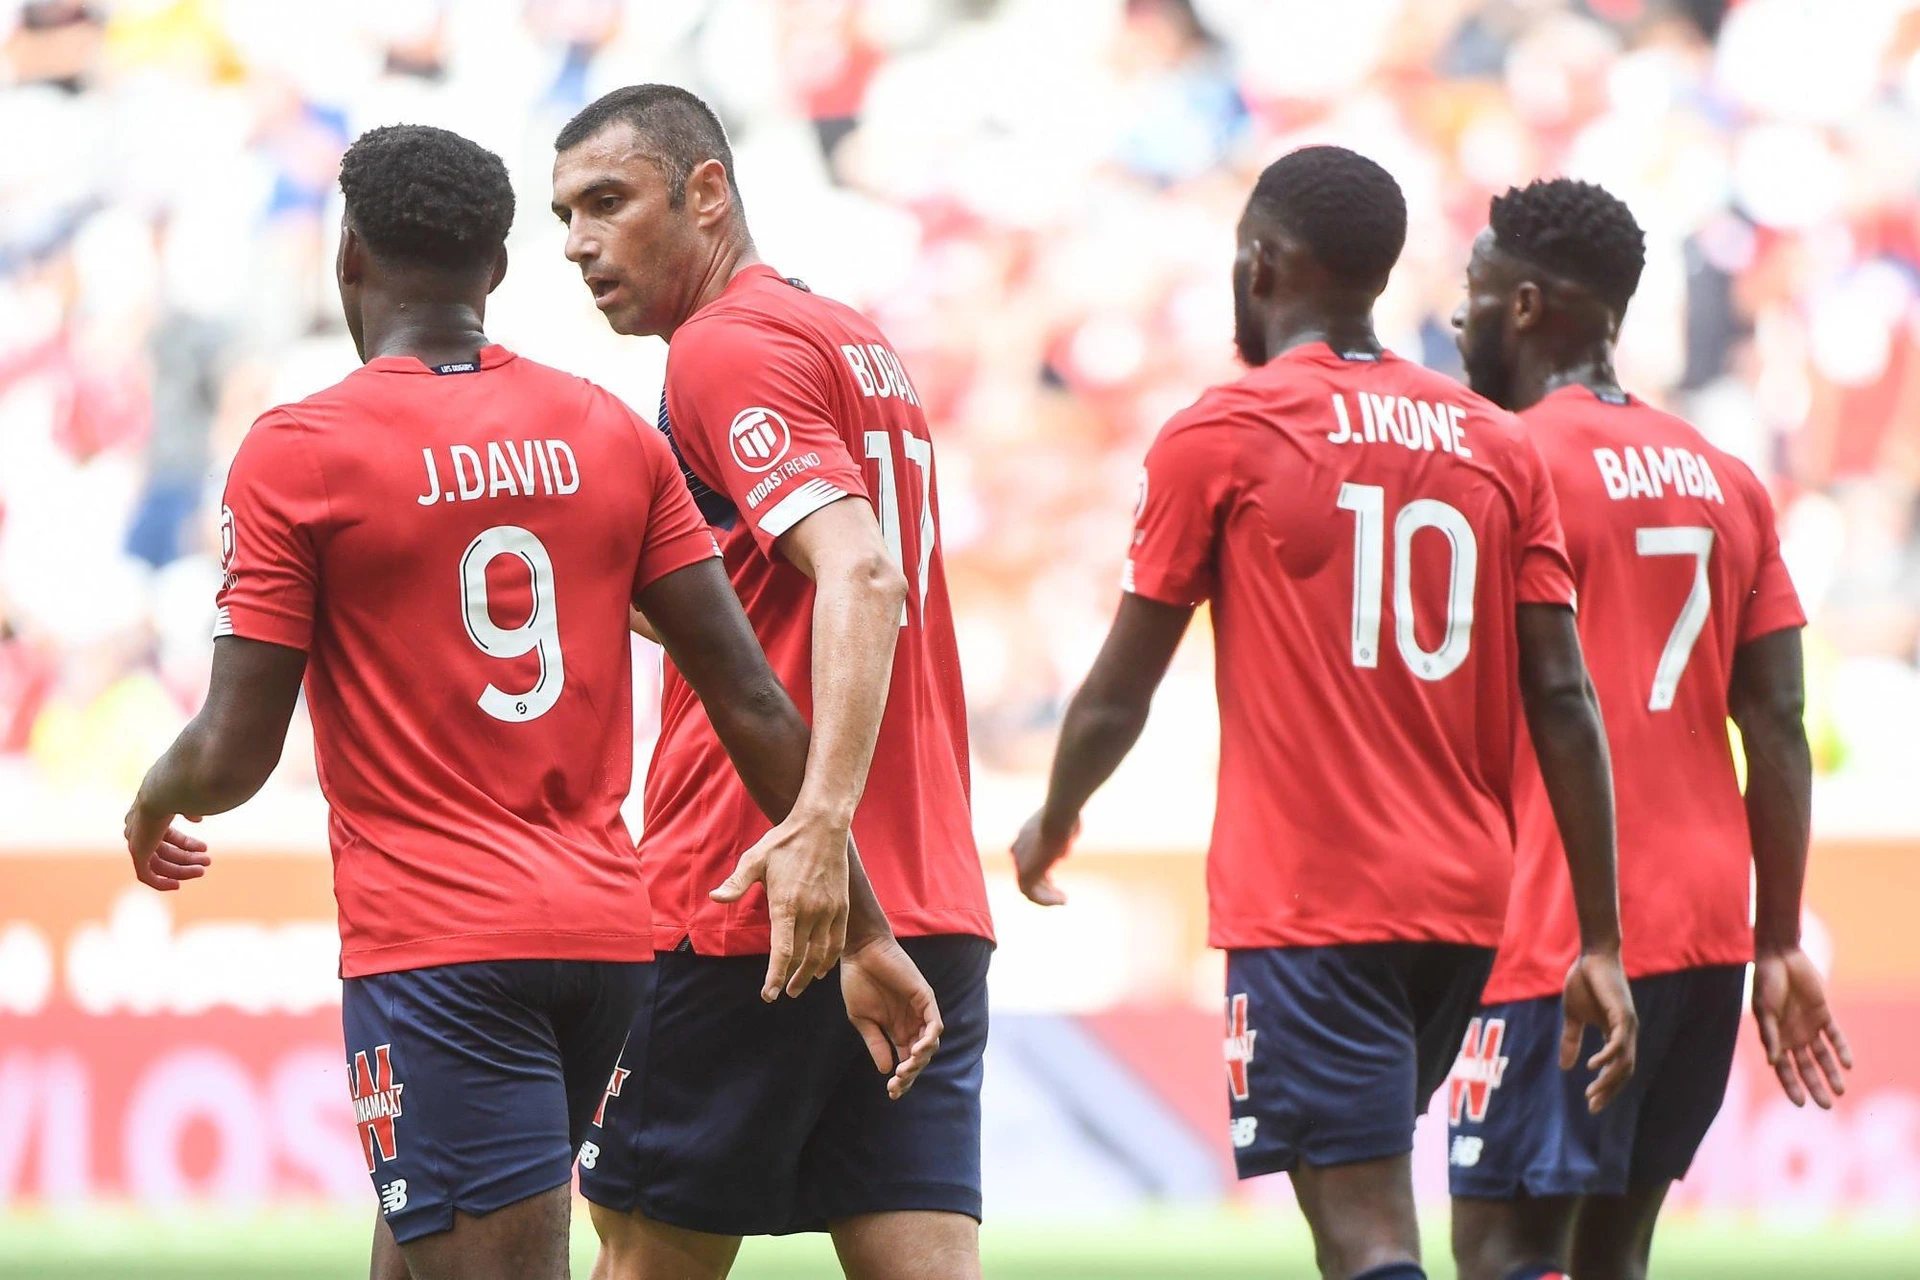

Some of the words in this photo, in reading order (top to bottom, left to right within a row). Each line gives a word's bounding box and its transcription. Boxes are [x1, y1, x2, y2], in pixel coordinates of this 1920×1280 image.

[417, 439, 581, 506] J.DAVID
[1327, 391, 1473, 458] J.IKONE
[1592, 445, 1725, 505] BAMBA
[863, 430, 935, 632] 17
[1336, 481, 1478, 681] 10
[1635, 526, 1715, 711] 7
[458, 525, 565, 723] 9
